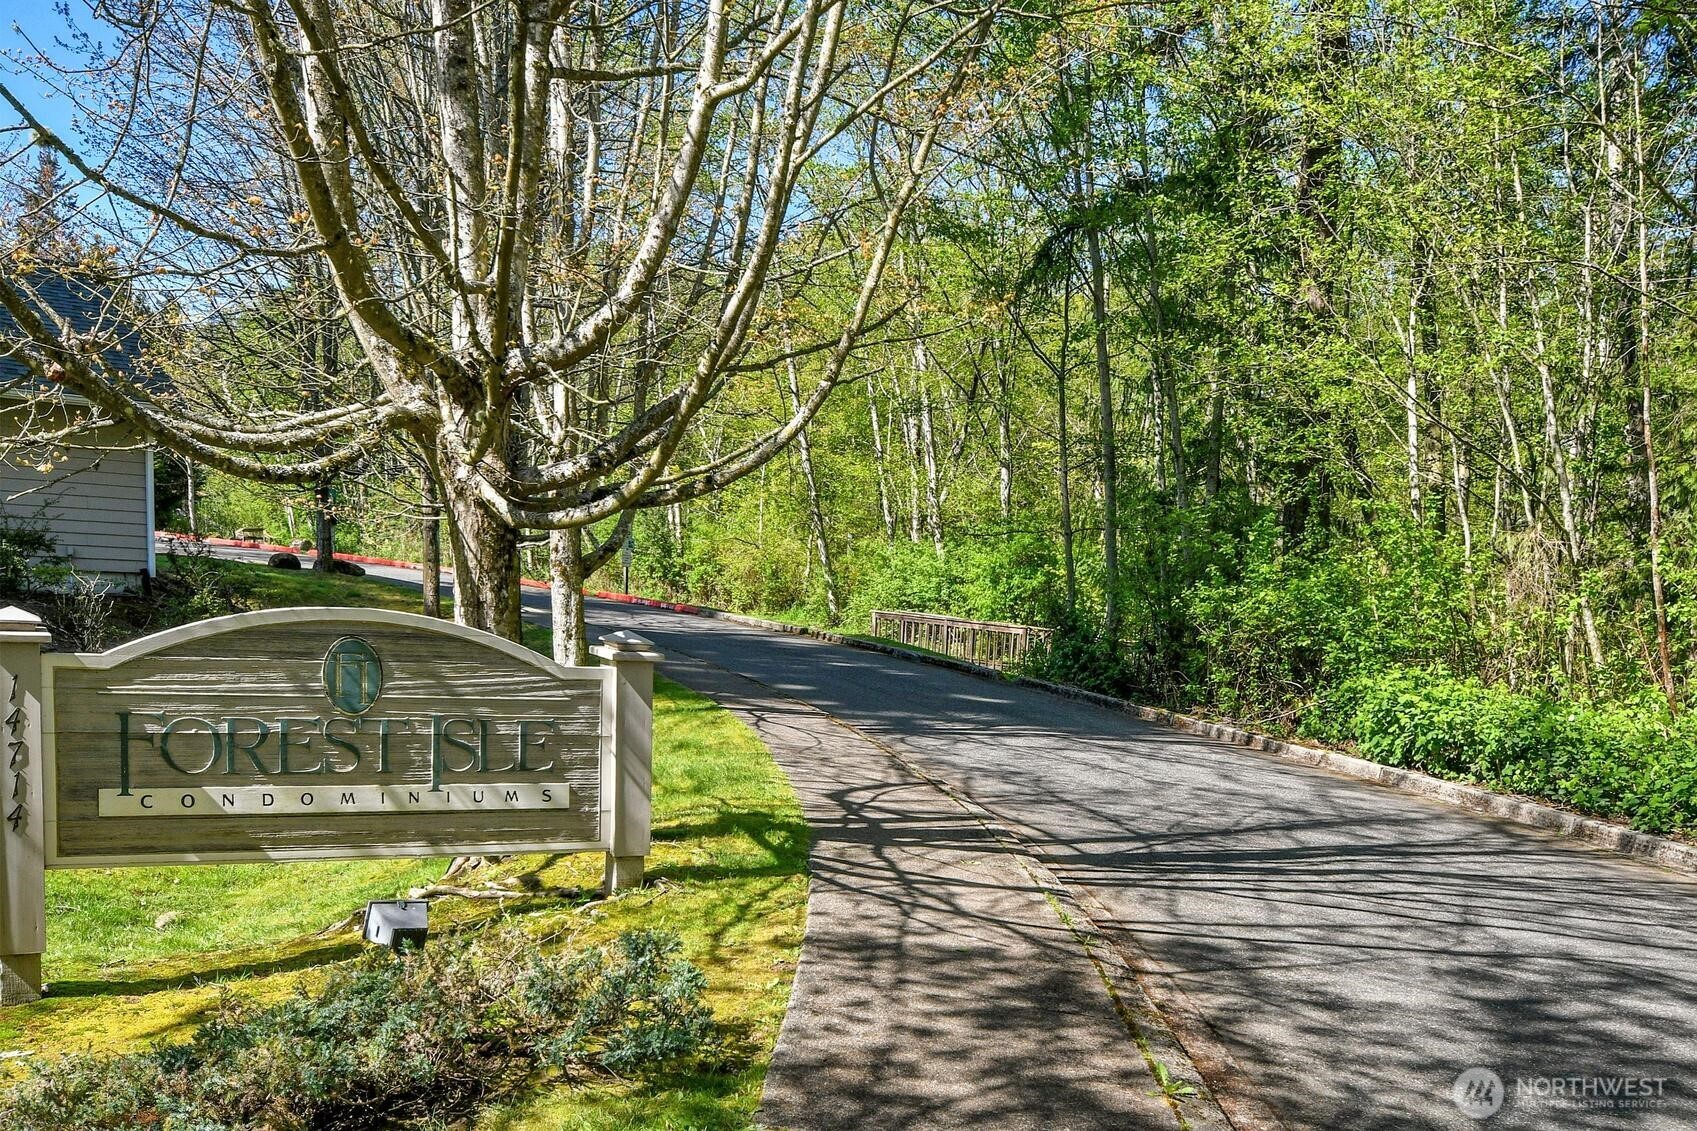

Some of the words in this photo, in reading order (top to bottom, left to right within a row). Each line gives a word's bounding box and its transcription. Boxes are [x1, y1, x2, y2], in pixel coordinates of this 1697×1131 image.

[5, 674, 23, 832] 14714
[115, 711, 409, 796] FOREST
[428, 714, 555, 792] ISLE
[140, 789, 553, 808] CONDOMINIUMS
